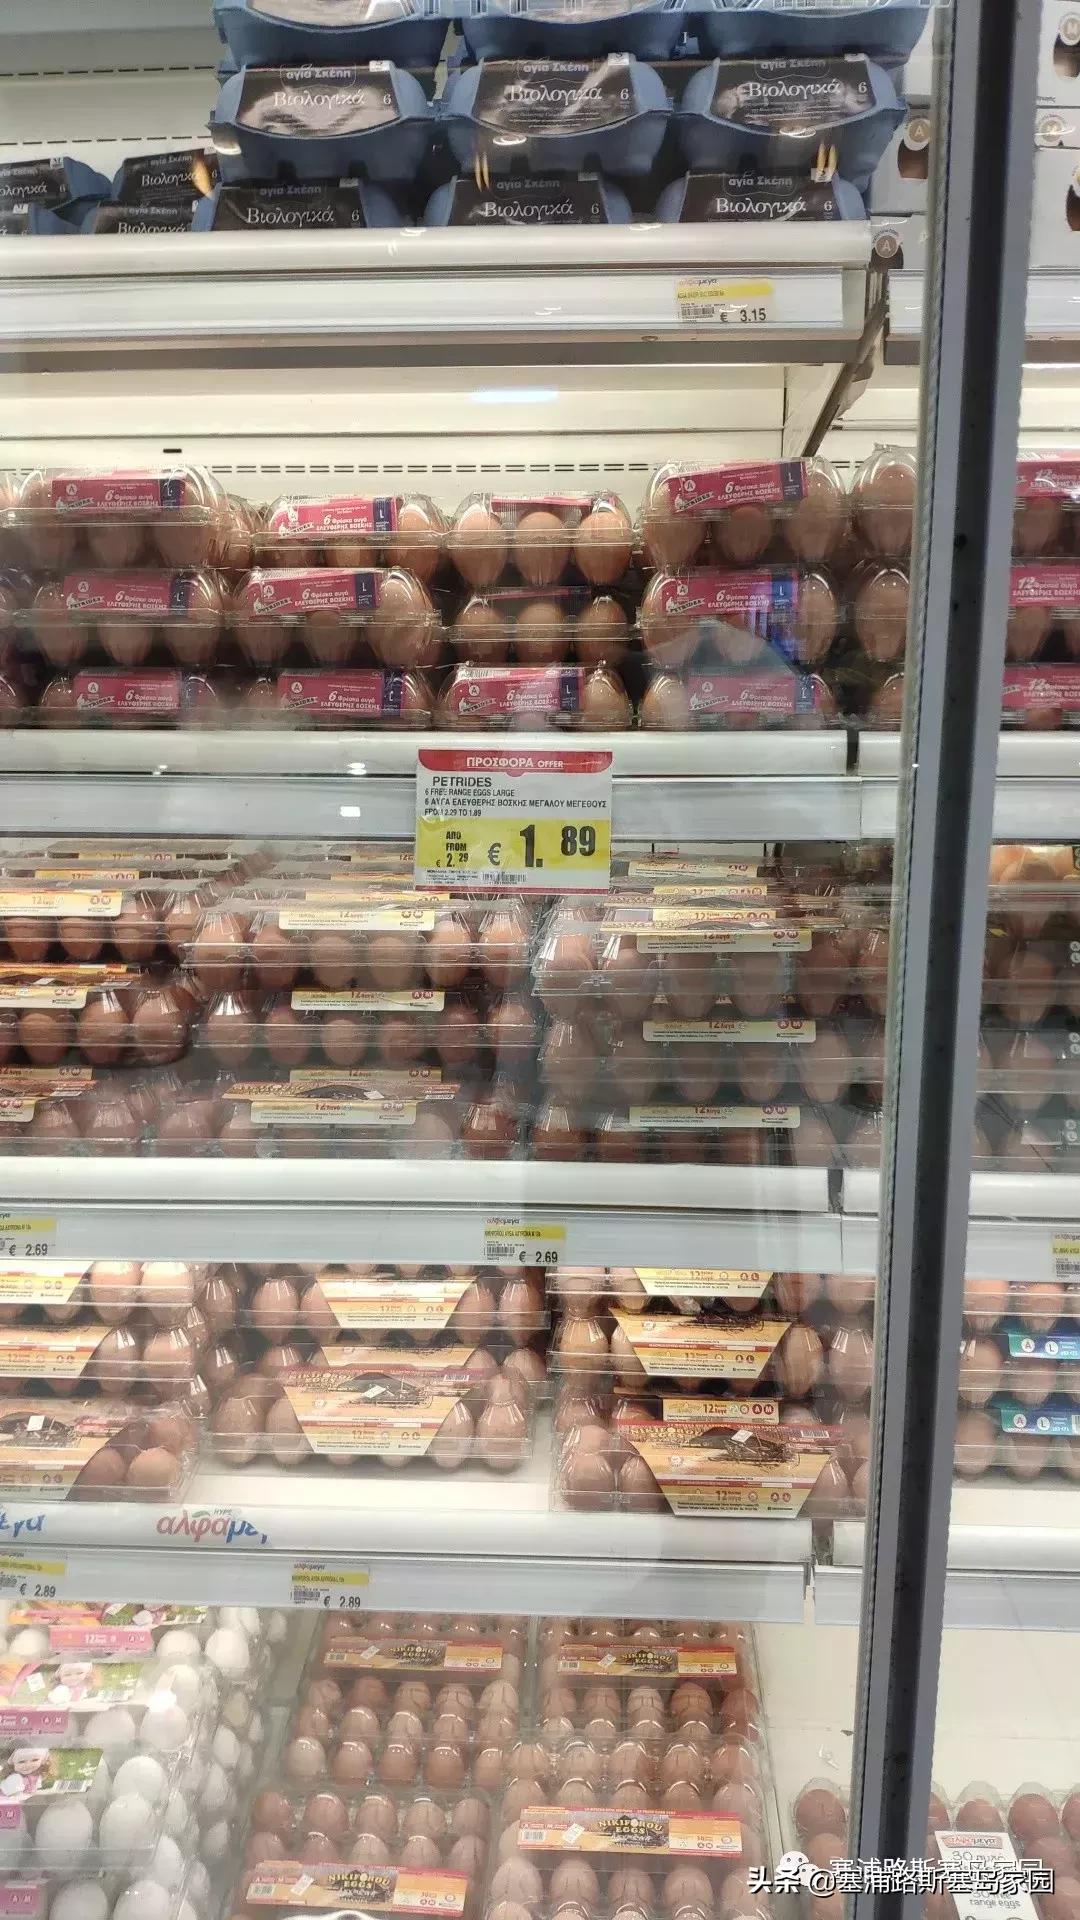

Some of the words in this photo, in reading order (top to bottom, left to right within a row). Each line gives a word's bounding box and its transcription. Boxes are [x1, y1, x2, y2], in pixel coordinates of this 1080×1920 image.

[620, 88, 630, 100] 6
[749, 79, 841, 99] Βιολογικά
[858, 82, 867, 93] 6
[273, 89, 366, 109] Βιολογικά
[383, 92, 392, 105] 6
[485, 199, 574, 220] Βιολογικά
[591, 203, 600, 215] 6
[716, 196, 807, 218] Βιολογικά
[823, 200, 833, 212] 6
[247, 205, 335, 228] Βιολογικά
[351, 210, 360, 221] 6
[740, 308, 767, 322] 3.15
[725, 481, 734, 493] 6
[105, 490, 114, 501] 6
[323, 514, 332, 525] 6
[115, 590, 124, 601] 6
[302, 588, 311, 600] 6
[716, 590, 726, 602] 6
[125, 690, 135, 701] 6
[328, 691, 338, 702] 6
[506, 689, 516, 701] 6
[740, 688, 750, 700] 6
[466, 757, 534, 768] ΠΡΟΣΦΟΡΑ
[537, 760, 564, 768] OFFER
[432, 776, 492, 787] PETRIDES
[448, 789, 472, 797] RANGE
[473, 789, 491, 797] EGGS
[492, 789, 515, 797] LARGE
[452, 799, 496, 807] ΕΛΕΥΘΕΡΗΣ
[529, 800, 564, 808] ΜΕΓΑΛΟΥ
[446, 831, 461, 840] ΑΠΟ
[446, 843, 466, 851] FROM
[487, 843, 501, 866] €
[436, 859, 441, 867] €
[9, 1244, 16, 1256] €
[25, 1243, 48, 1256] 2.69
[519, 1250, 526, 1262] €
[536, 1251, 558, 1263] 2.69
[703, 1403, 715, 1414] 12
[156, 1509, 268, 1544] αλφαμε
[19, 1583, 27, 1595] €
[34, 1584, 56, 1598] 2.89
[323, 1595, 331, 1607] €
[339, 1596, 361, 1608] 2.89
[615, 1826, 646, 1835] EGGS
